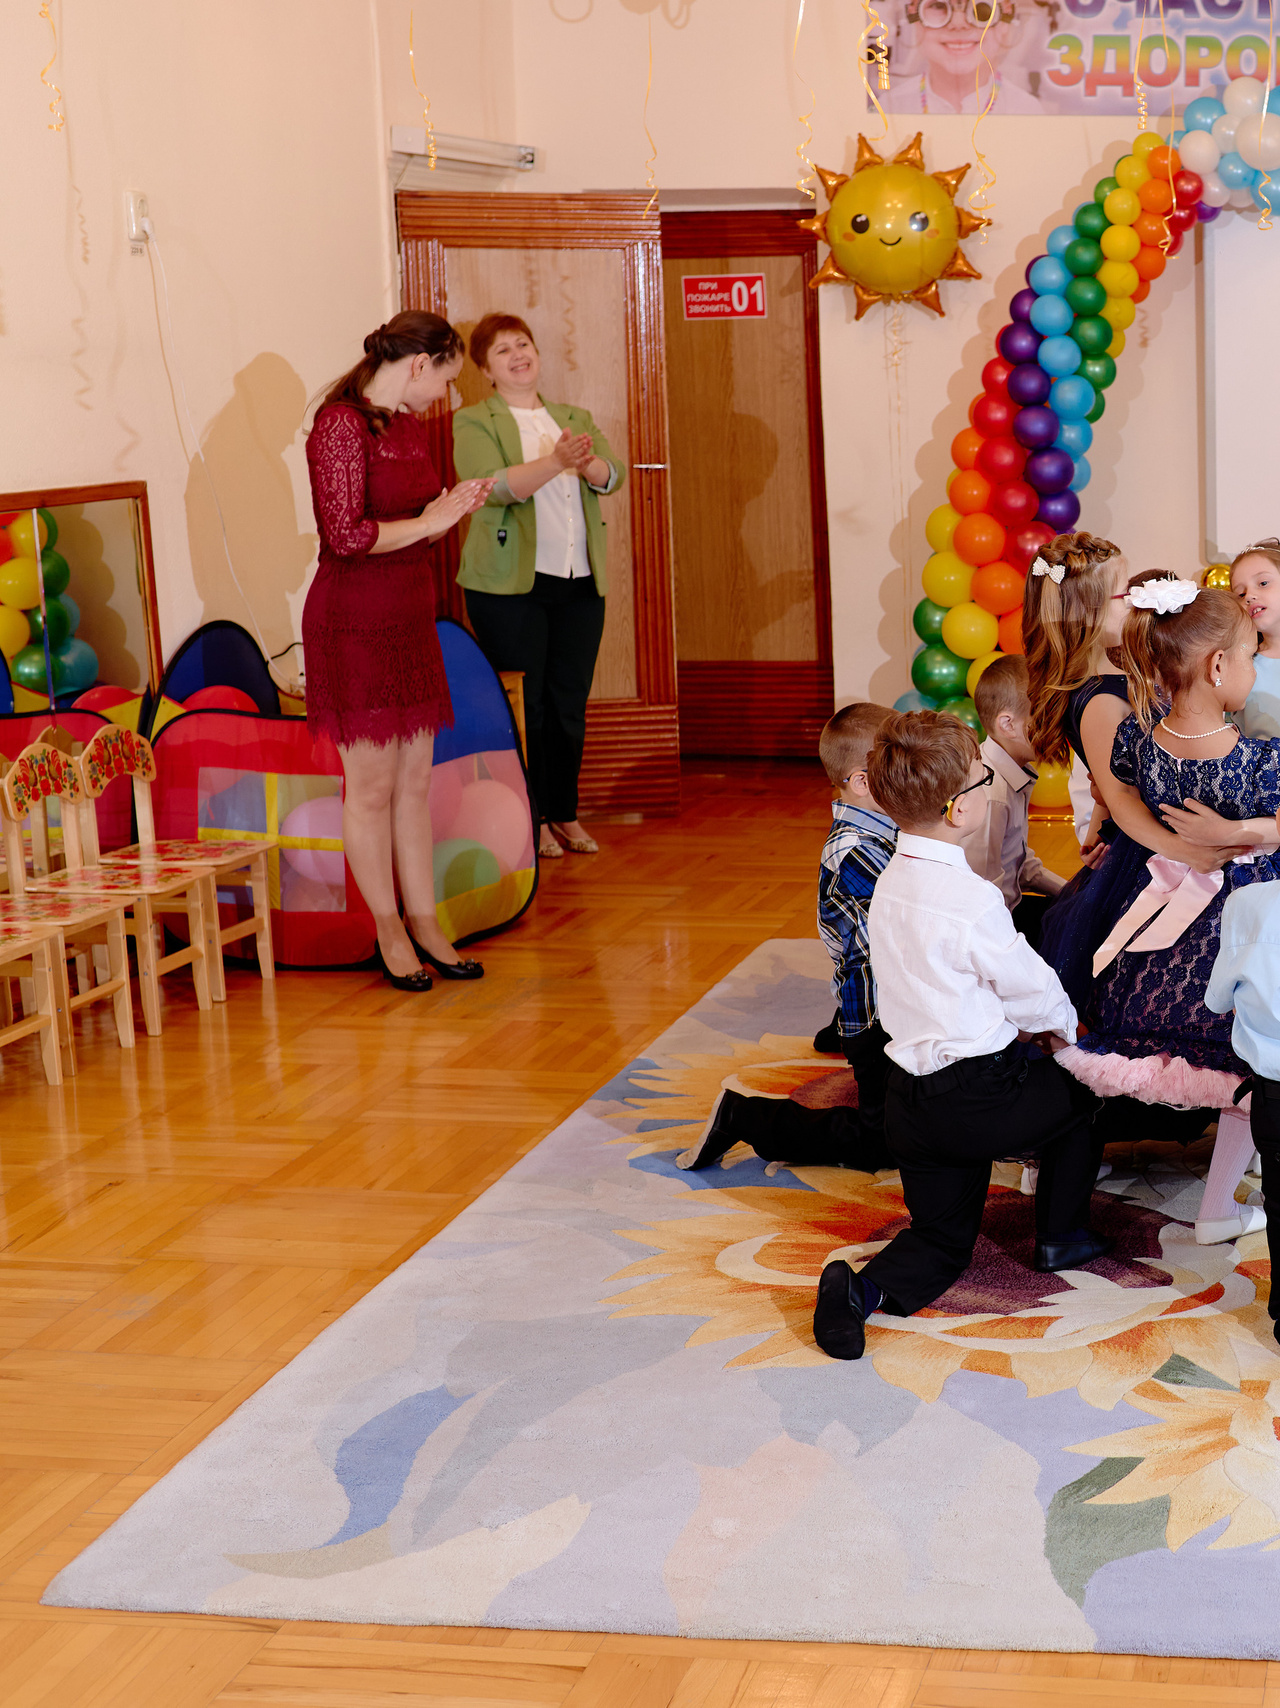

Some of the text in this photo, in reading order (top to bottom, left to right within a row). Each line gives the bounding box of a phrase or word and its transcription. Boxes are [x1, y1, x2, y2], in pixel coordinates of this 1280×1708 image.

[698, 282, 718, 290] ПРИ
[687, 293, 730, 302] ПОЖАРЕ
[731, 280, 764, 312] 01
[688, 304, 732, 313] ЗВОНИТЬ
